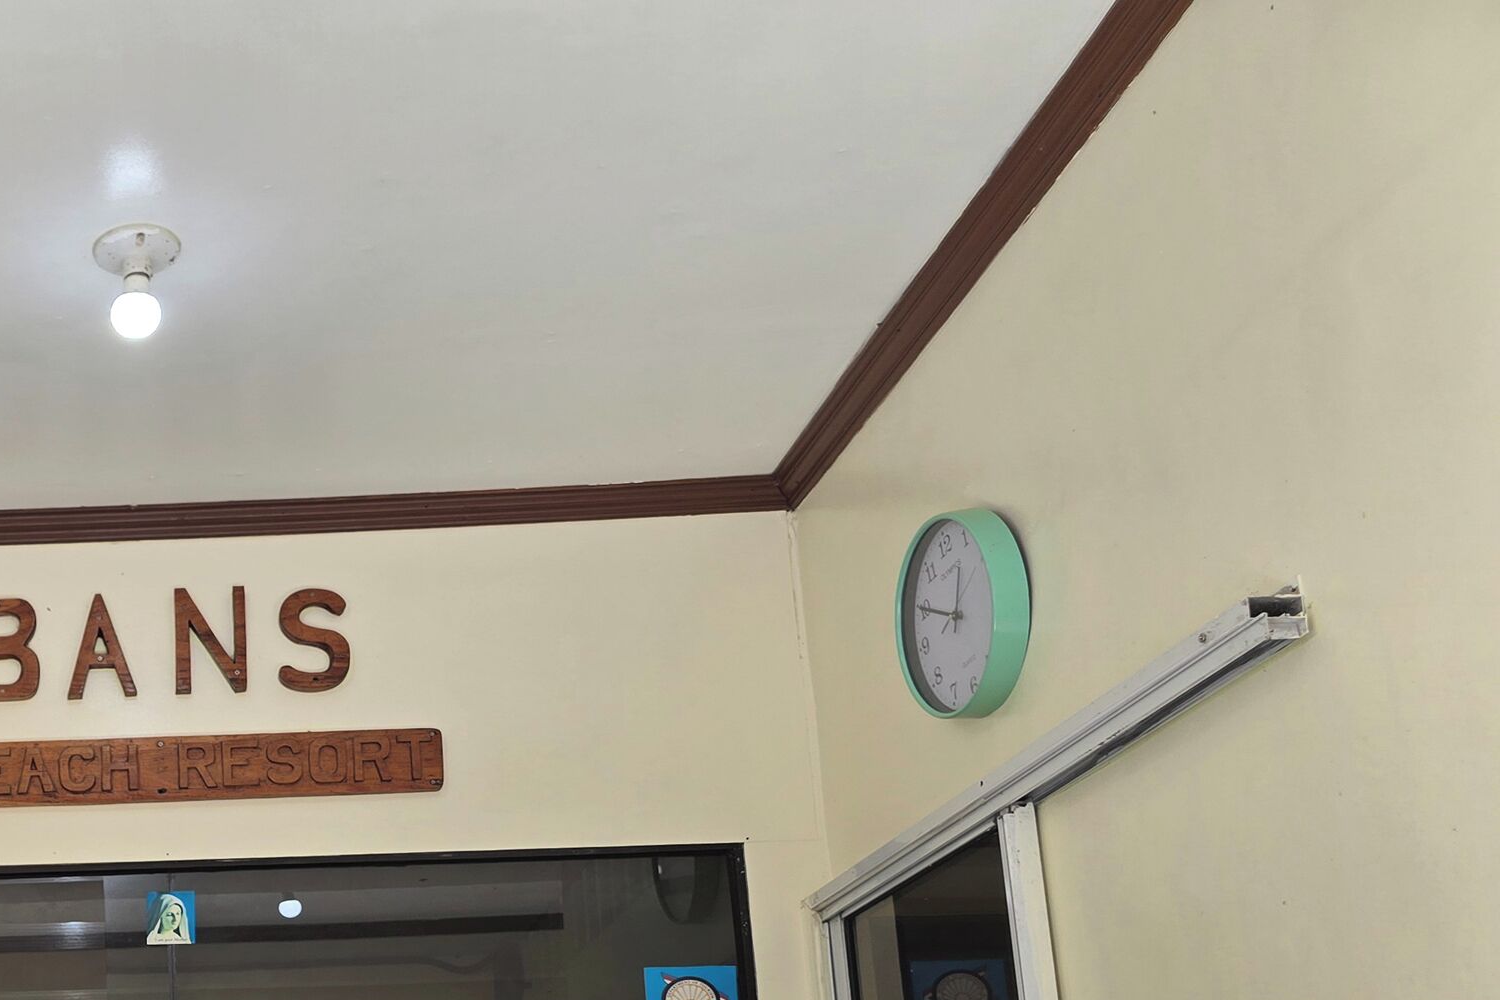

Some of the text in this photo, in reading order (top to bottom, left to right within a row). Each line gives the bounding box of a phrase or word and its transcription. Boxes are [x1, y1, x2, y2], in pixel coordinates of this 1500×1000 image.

[938, 534, 953, 560] 12
[962, 529, 970, 548] 1
[924, 564, 938, 585] 11
[920, 598, 931, 621] 10
[921, 636, 930, 656] 9
[933, 666, 944, 685] 8
[969, 676, 979, 694] 6
[950, 682, 958, 700] 7
[176, 732, 431, 790] RESORT
